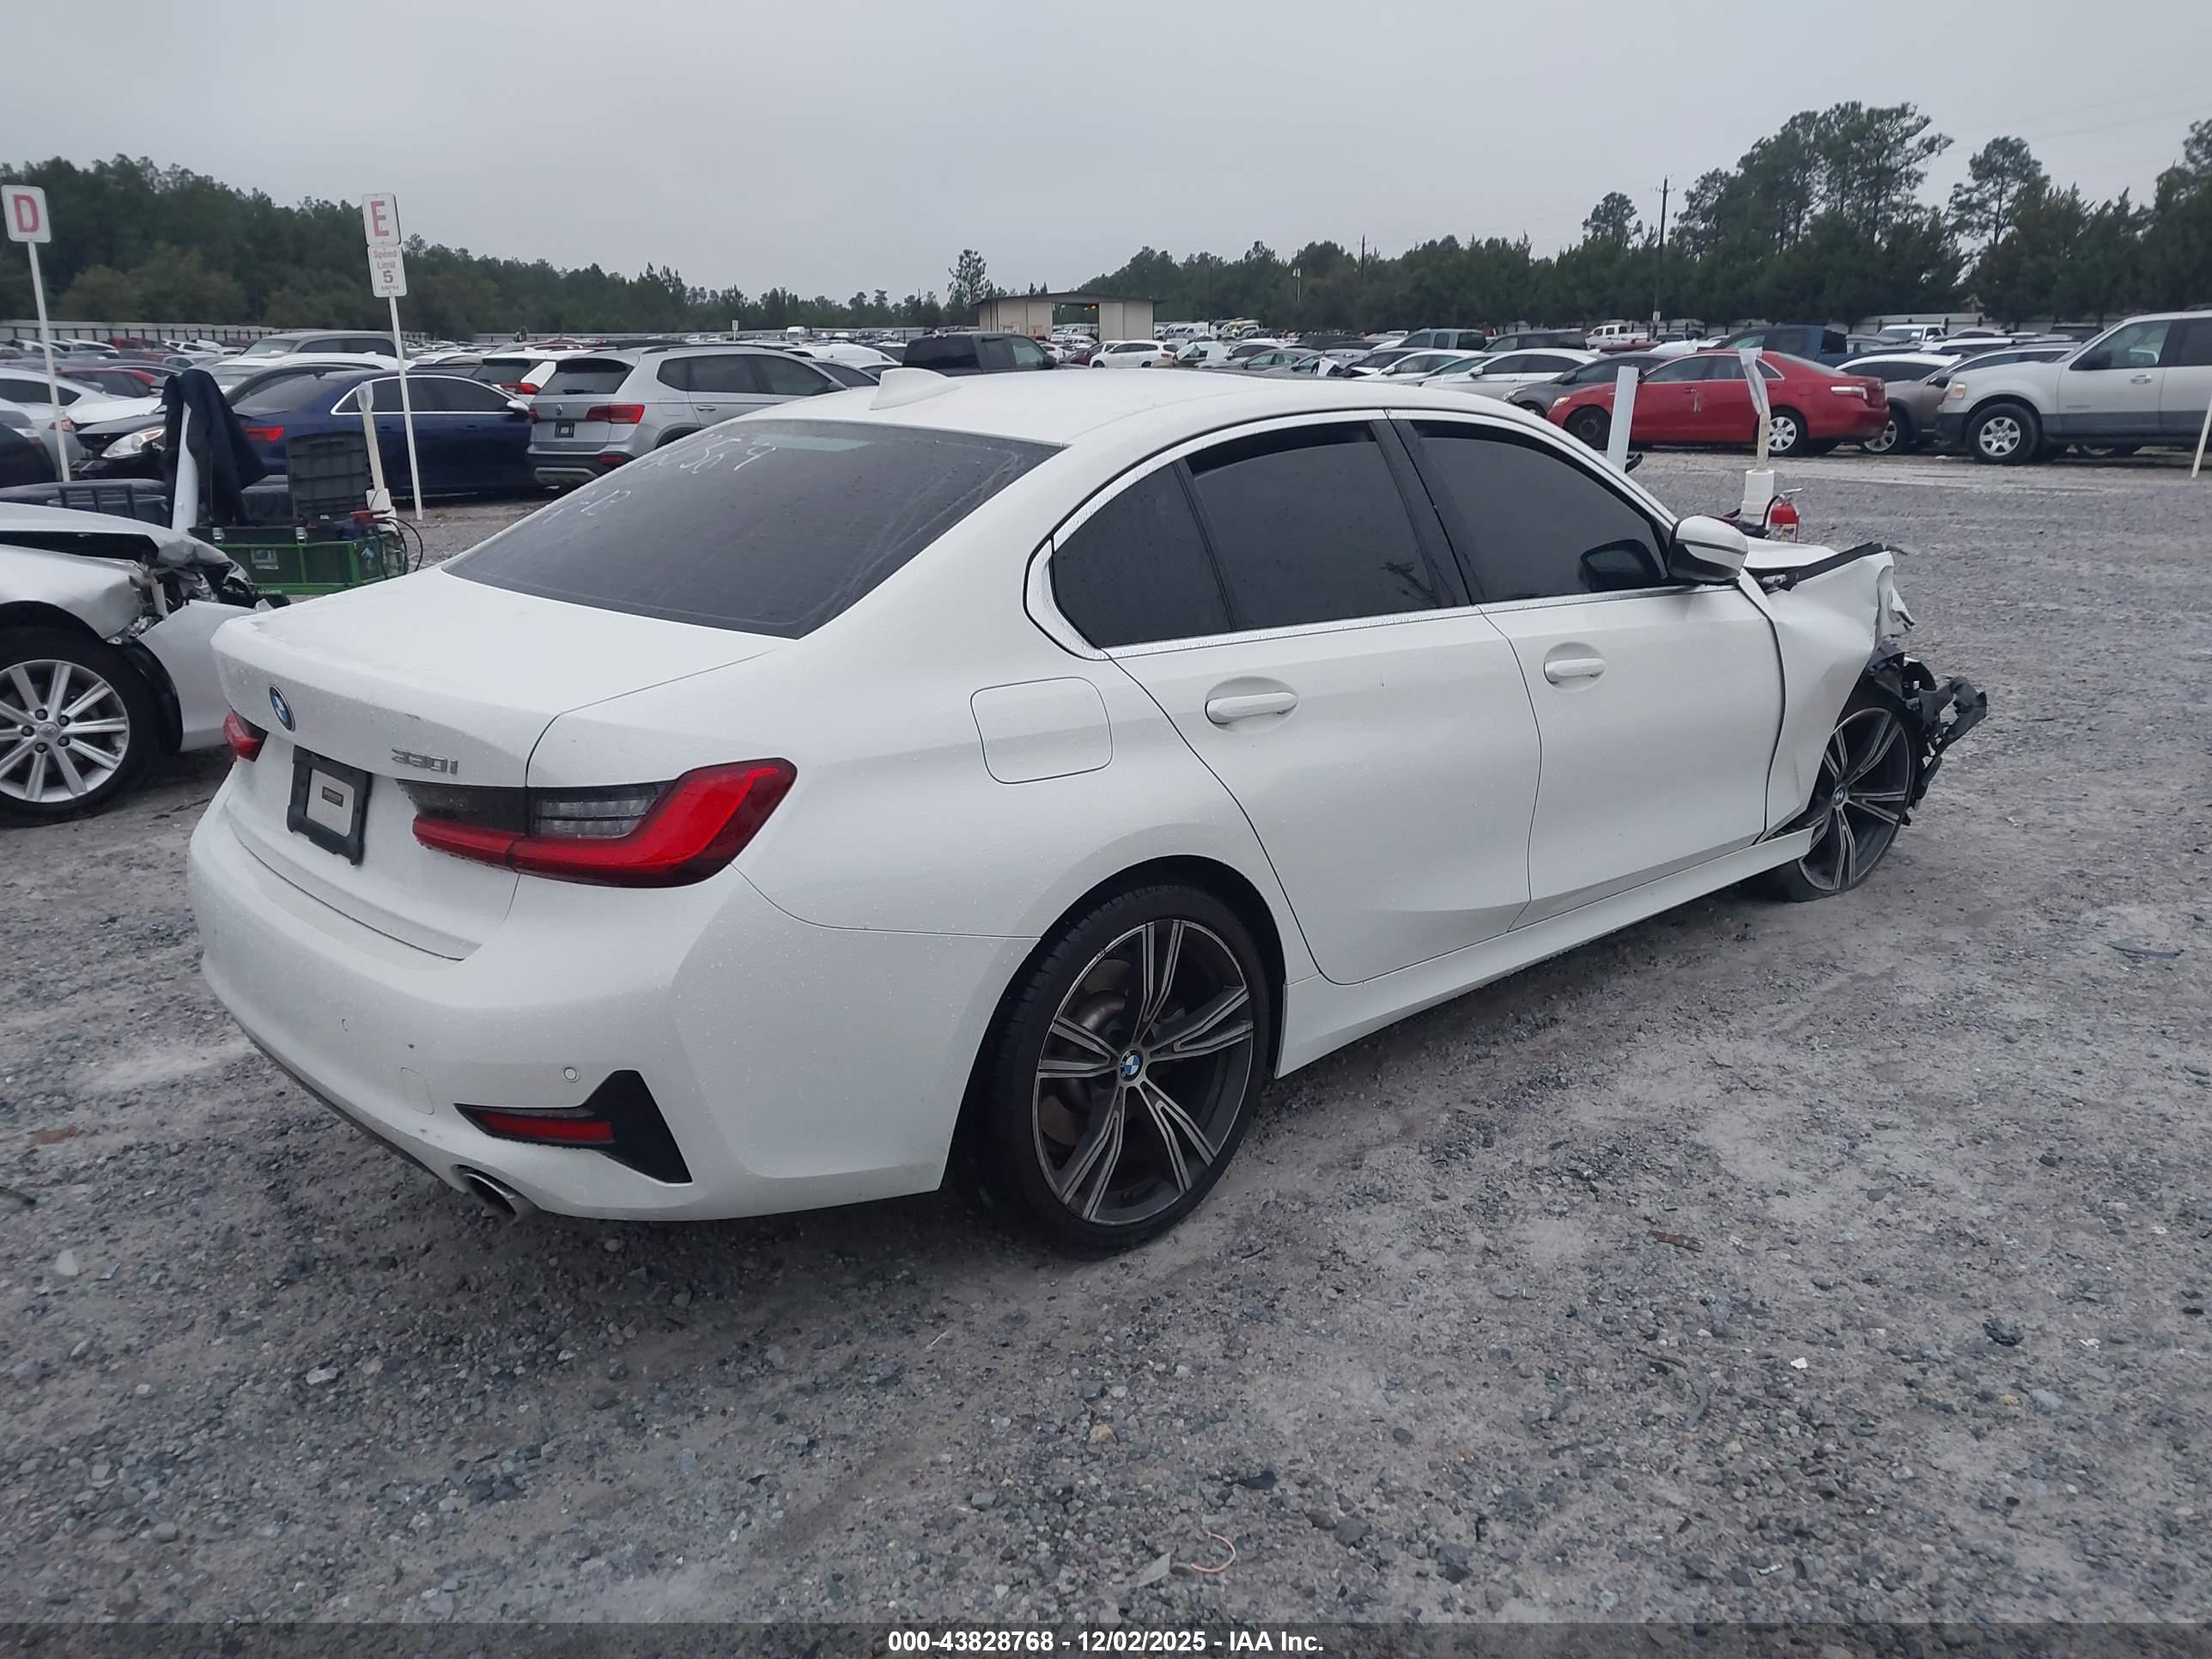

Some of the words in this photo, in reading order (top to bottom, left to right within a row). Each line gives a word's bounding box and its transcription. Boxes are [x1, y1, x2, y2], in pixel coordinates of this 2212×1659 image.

[13, 194, 40, 233] D
[370, 200, 390, 237] E
[372, 249, 398, 259] Speed
[377, 261, 396, 270] Limit
[383, 270, 393, 283] 5
[392, 747, 459, 775] 330i
